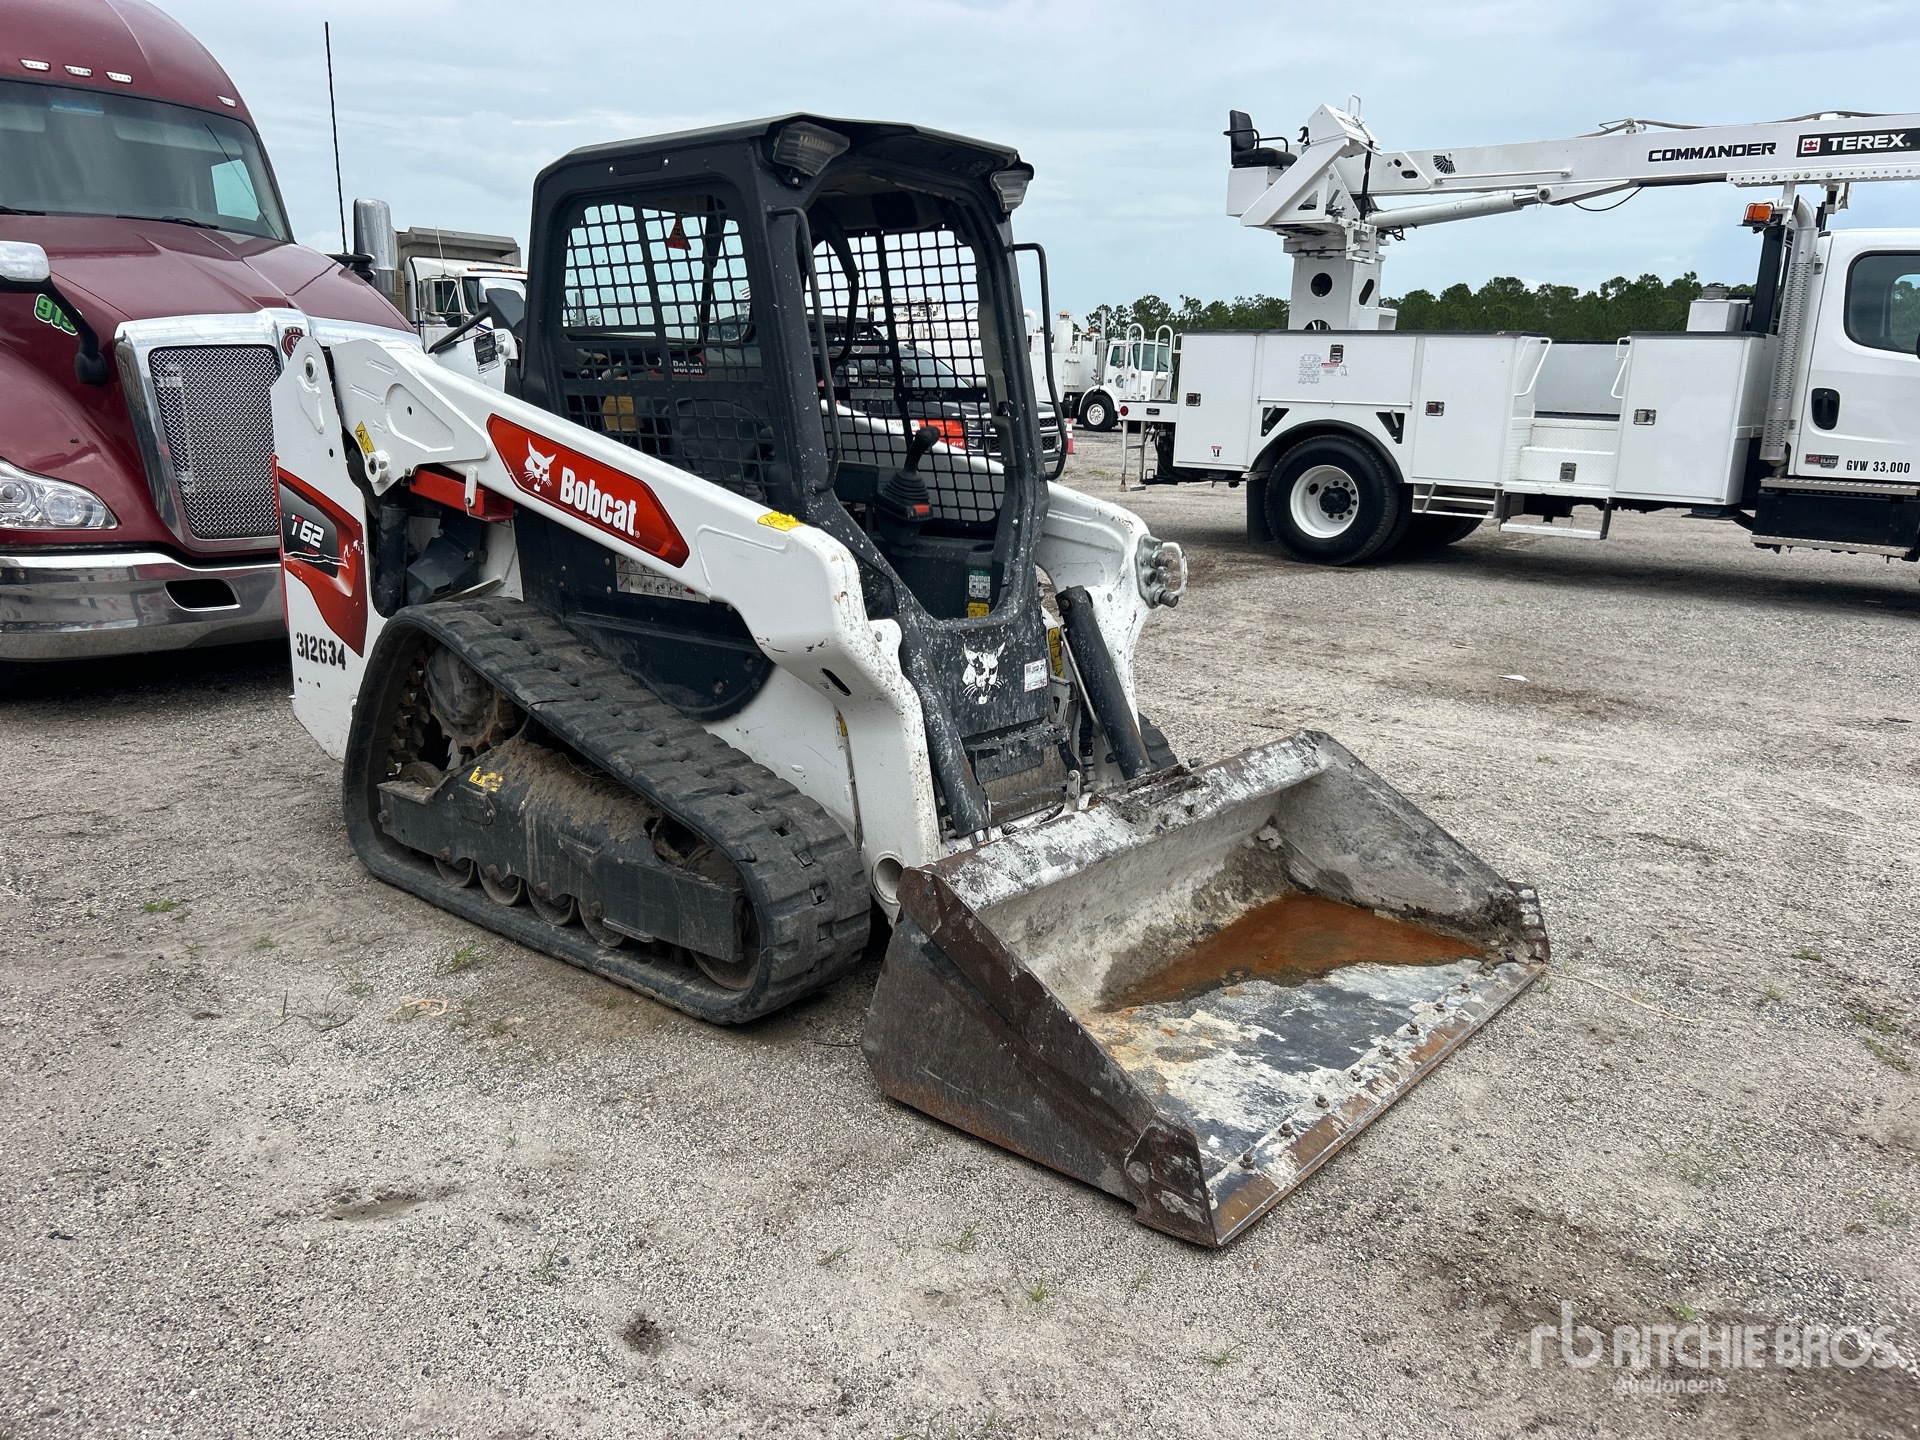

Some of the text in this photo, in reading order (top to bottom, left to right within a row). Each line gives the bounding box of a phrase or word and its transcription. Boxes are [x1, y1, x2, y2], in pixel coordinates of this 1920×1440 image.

[1648, 142, 1776, 162] COMMANDER
[1828, 133, 1906, 151] TEREX
[1846, 460, 1911, 474] GVW 33,000
[560, 466, 637, 536] Bobcat
[291, 514, 325, 549] T62
[296, 631, 346, 671] 312634
